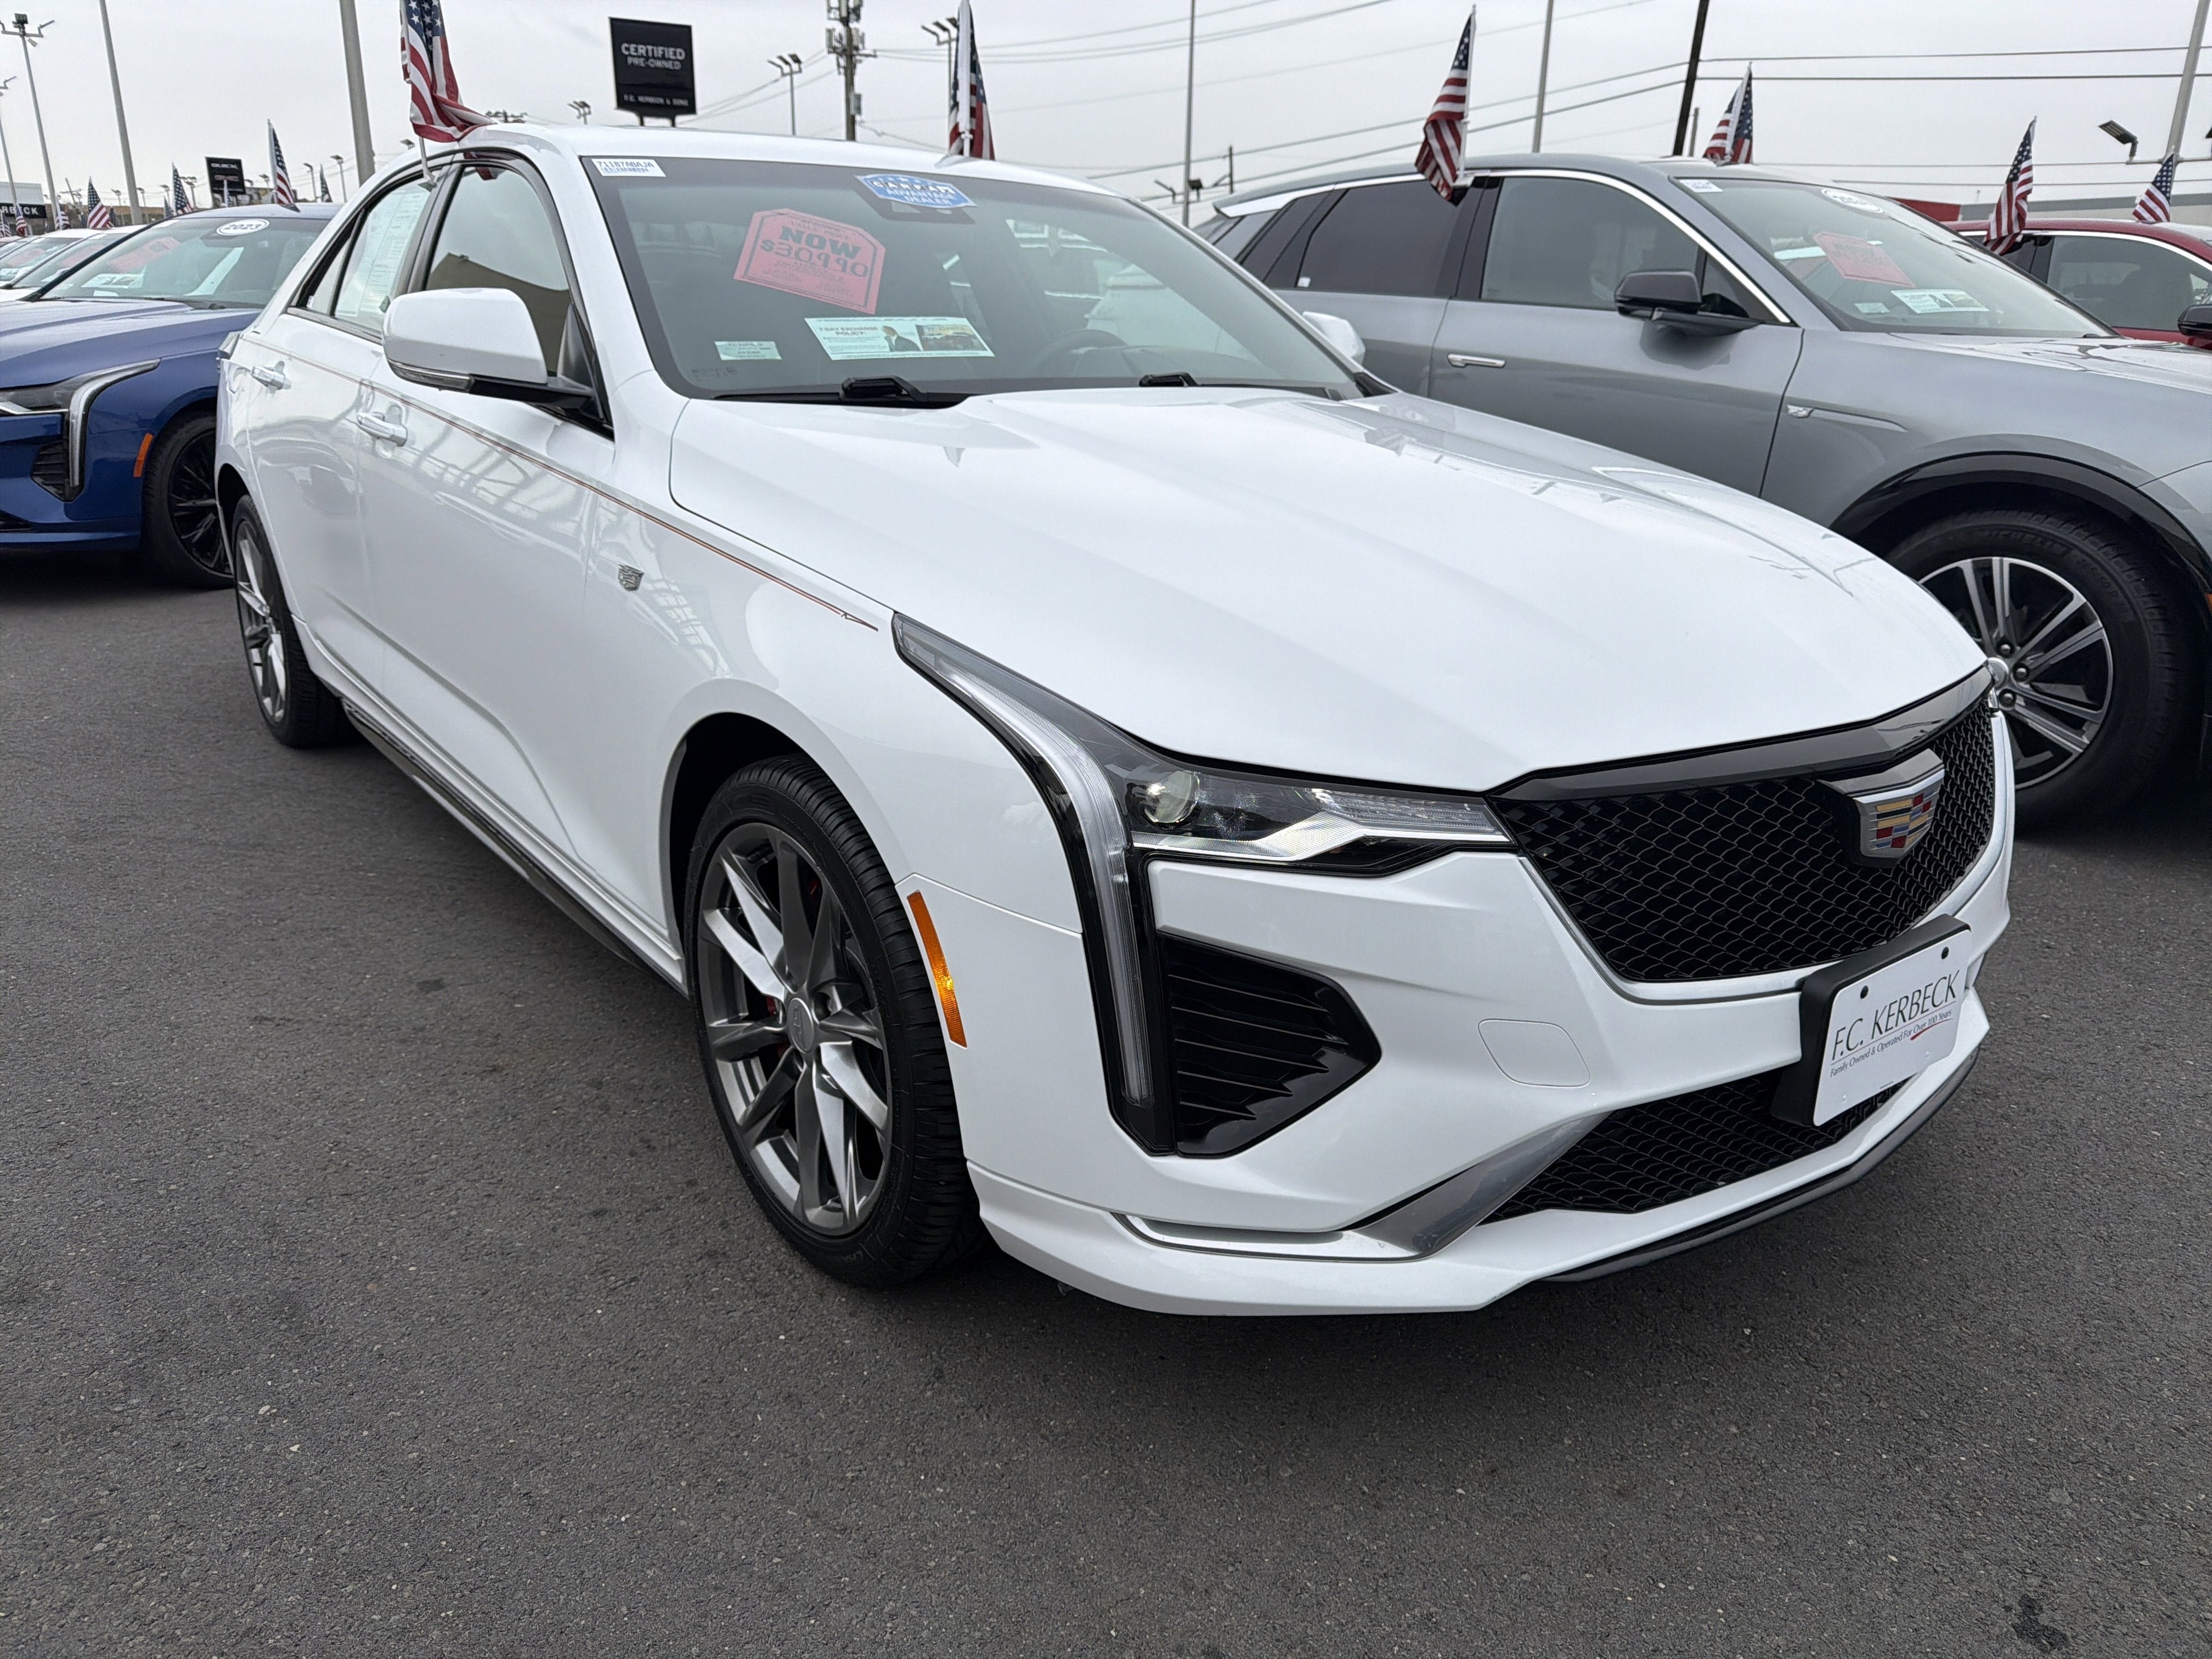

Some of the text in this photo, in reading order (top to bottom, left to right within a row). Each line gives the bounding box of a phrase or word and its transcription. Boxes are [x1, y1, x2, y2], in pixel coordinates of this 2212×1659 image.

[621, 43, 686, 60] CERTIFIED
[627, 57, 681, 70] PRE-OWNED
[781, 226, 861, 259] NOW
[1832, 969, 1960, 1060] F.C. KERBECK
[1830, 1010, 1953, 1077] Family Owned & Operated For Over 100 Years
